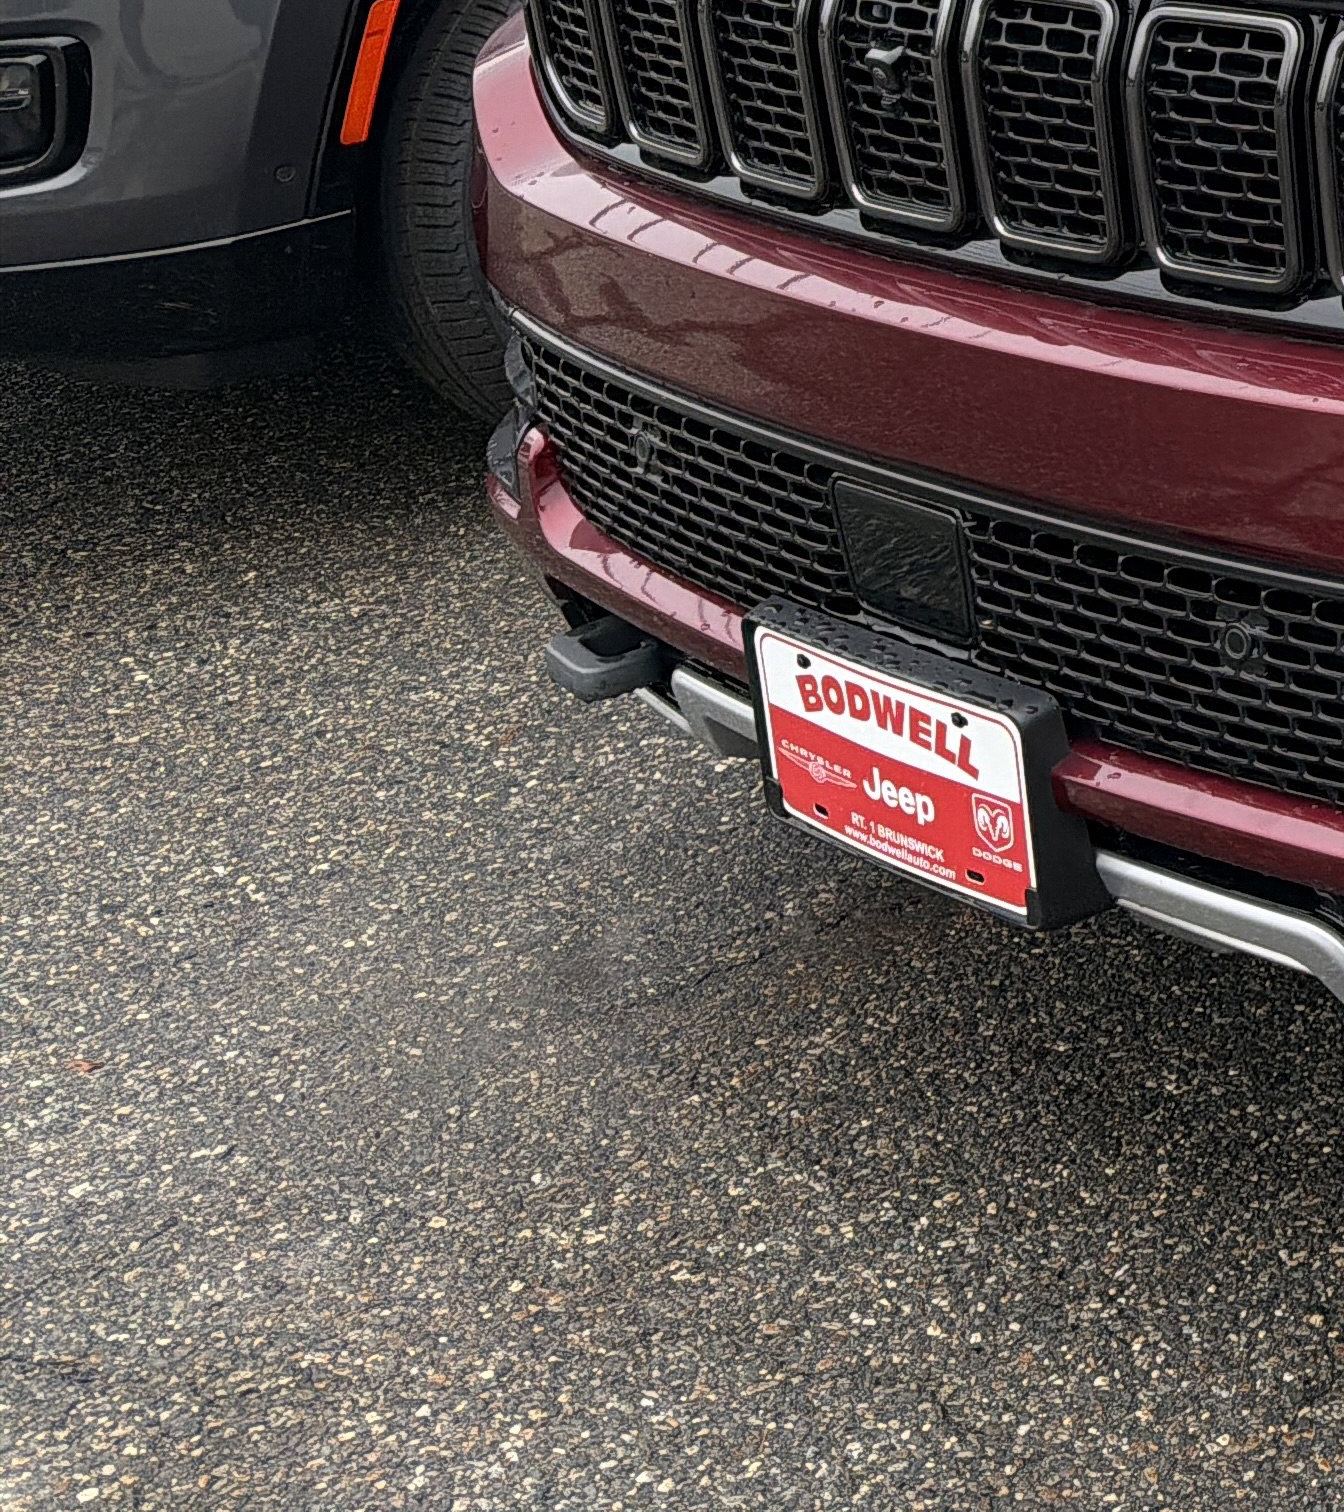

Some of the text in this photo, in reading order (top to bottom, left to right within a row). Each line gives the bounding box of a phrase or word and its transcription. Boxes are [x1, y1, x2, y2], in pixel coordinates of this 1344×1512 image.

[796, 674, 980, 781] BODWELL
[781, 739, 853, 778] CHRYSLER
[863, 767, 935, 825] Jeep
[844, 824, 957, 881] www.bodwellauto.com
[851, 811, 945, 863] RT. 1 BRUNSWICK
[972, 847, 1023, 872] DODGE
